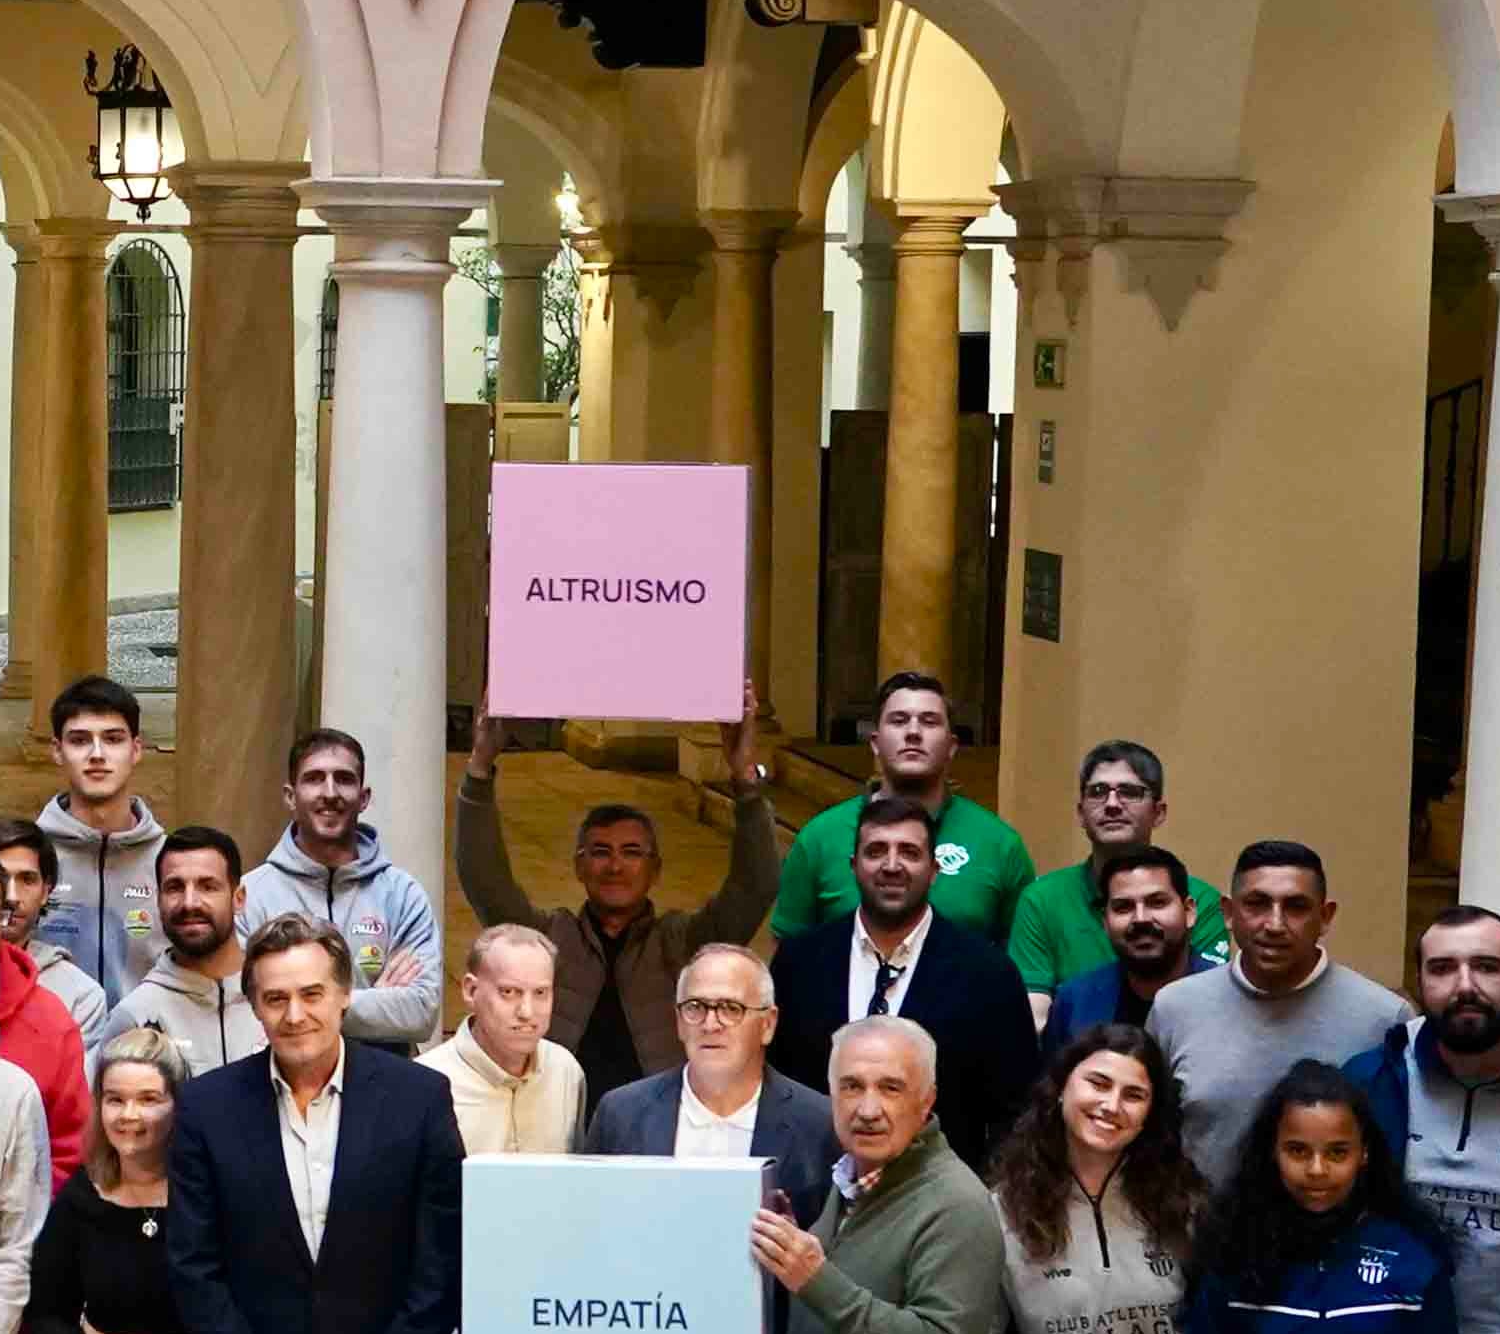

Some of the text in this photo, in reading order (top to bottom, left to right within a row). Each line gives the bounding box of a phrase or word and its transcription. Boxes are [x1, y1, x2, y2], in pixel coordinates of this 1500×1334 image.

[525, 577, 707, 604] ALTRUISMO
[532, 1291, 689, 1330] EMPATÍA
[1046, 1316, 1089, 1334] CLUB
